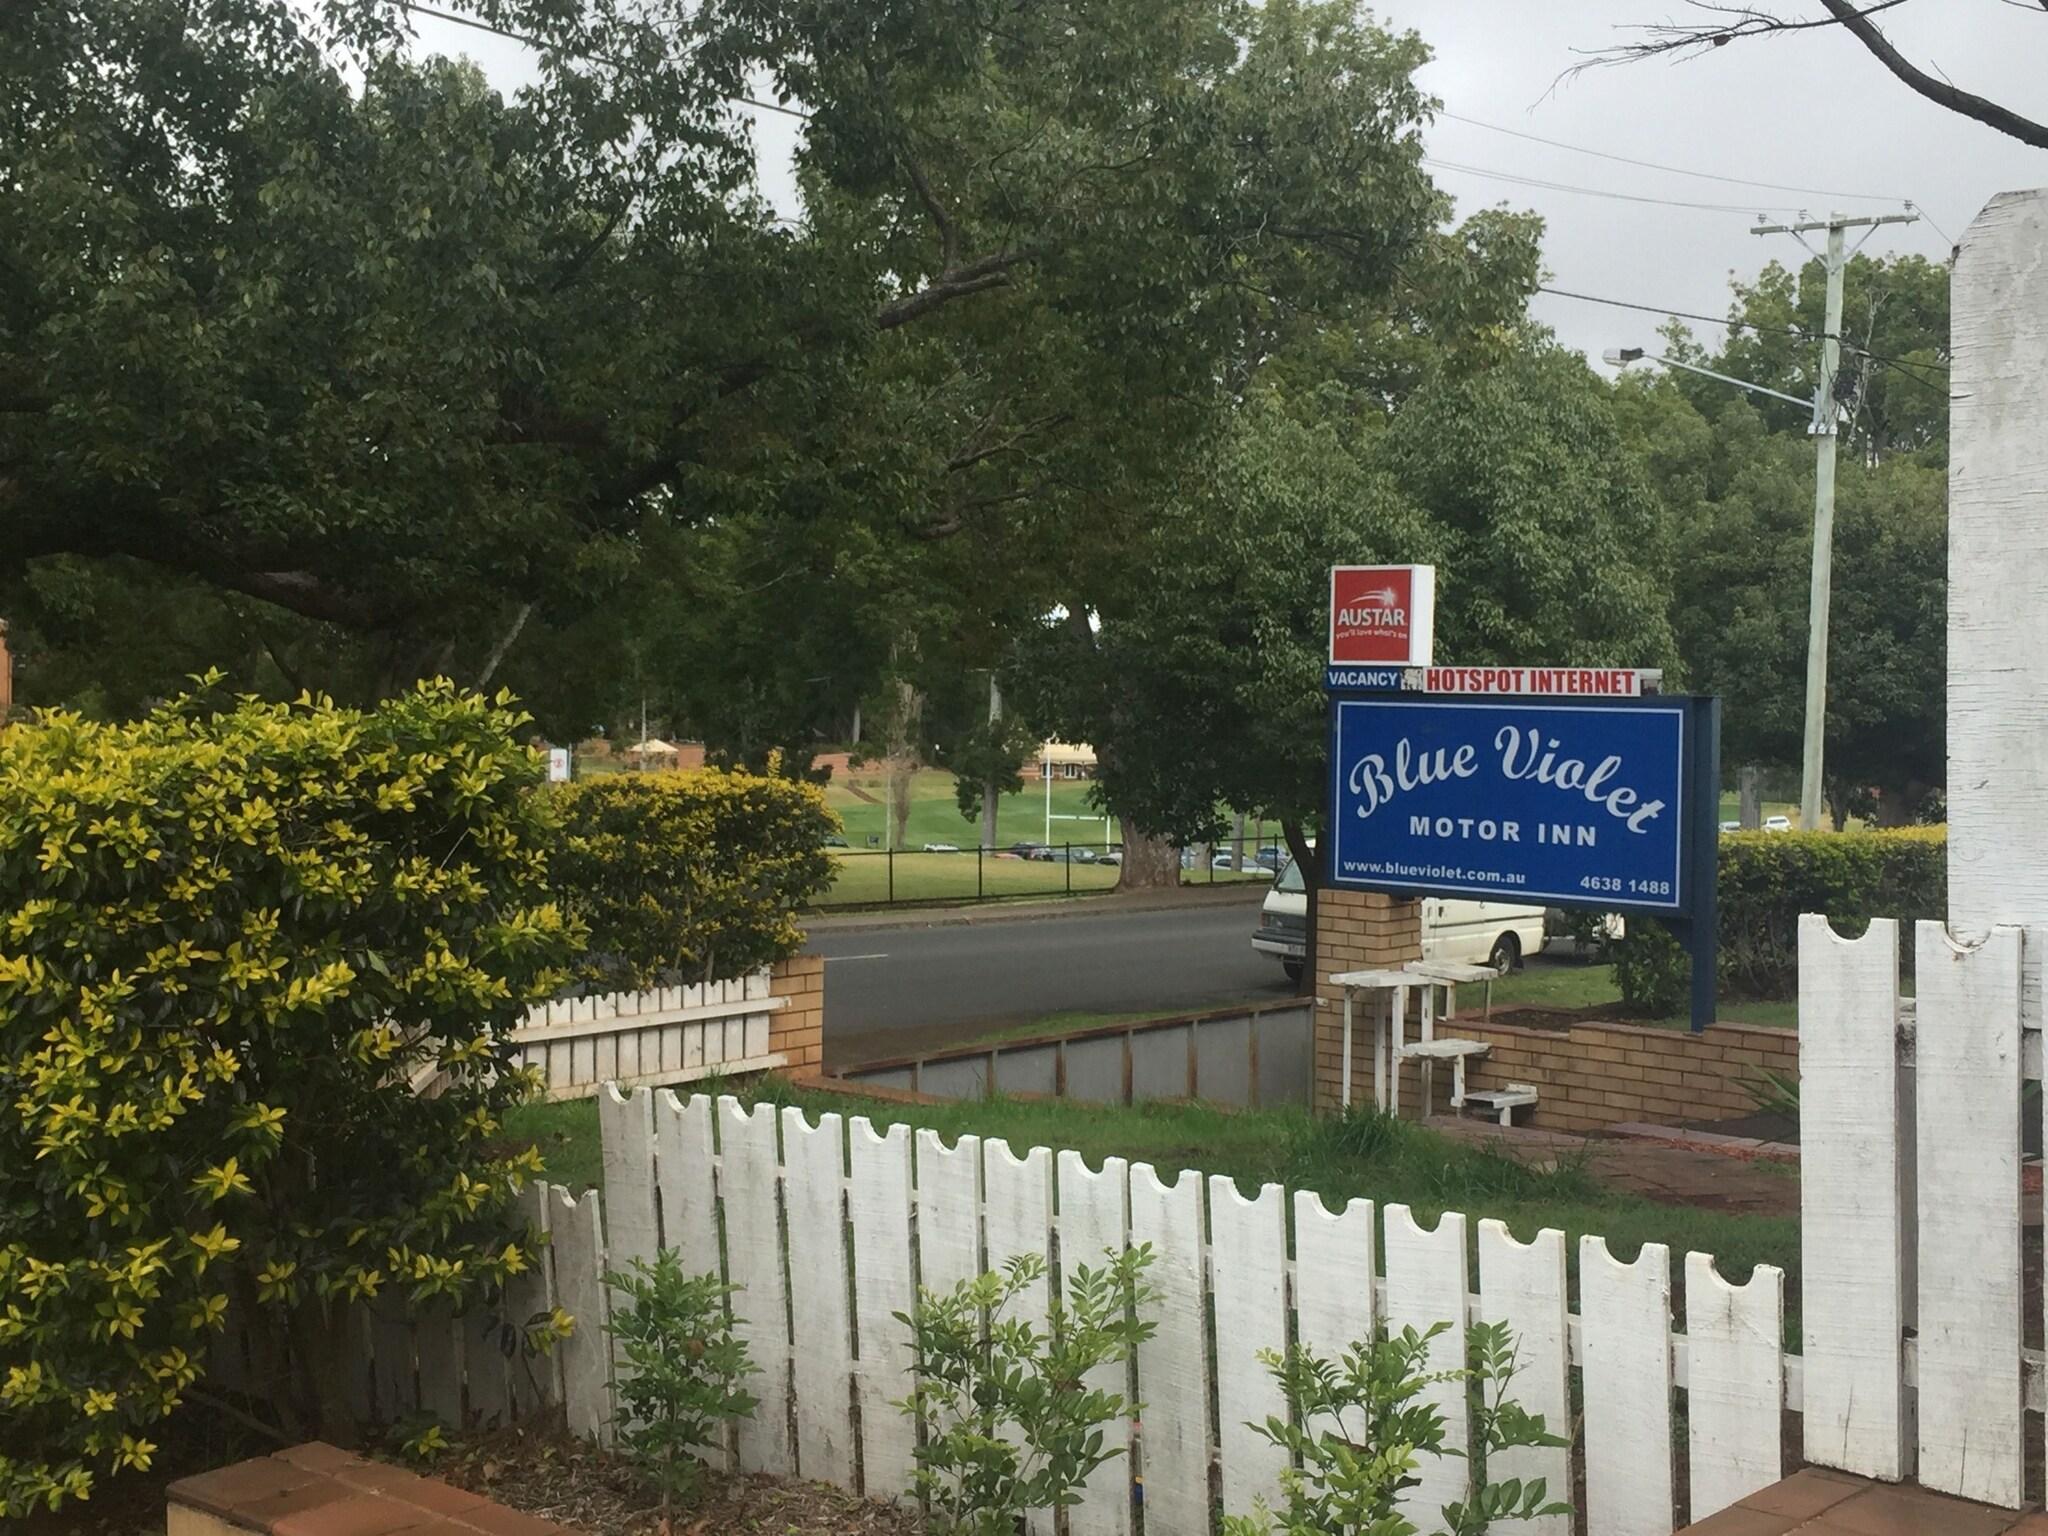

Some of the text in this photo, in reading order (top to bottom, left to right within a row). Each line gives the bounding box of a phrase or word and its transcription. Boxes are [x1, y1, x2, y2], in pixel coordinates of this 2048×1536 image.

[1337, 608, 1406, 627] AUSTAR
[1328, 671, 1398, 687] VACANCY
[1427, 668, 1635, 694] HOTSPOT INTERNET
[1349, 725, 1665, 834] Blue Violet
[1409, 815, 1597, 847] MOTOR INN
[1343, 859, 1526, 885] www.blueviolet.com.au
[1580, 875, 1670, 896] 4638 1488
